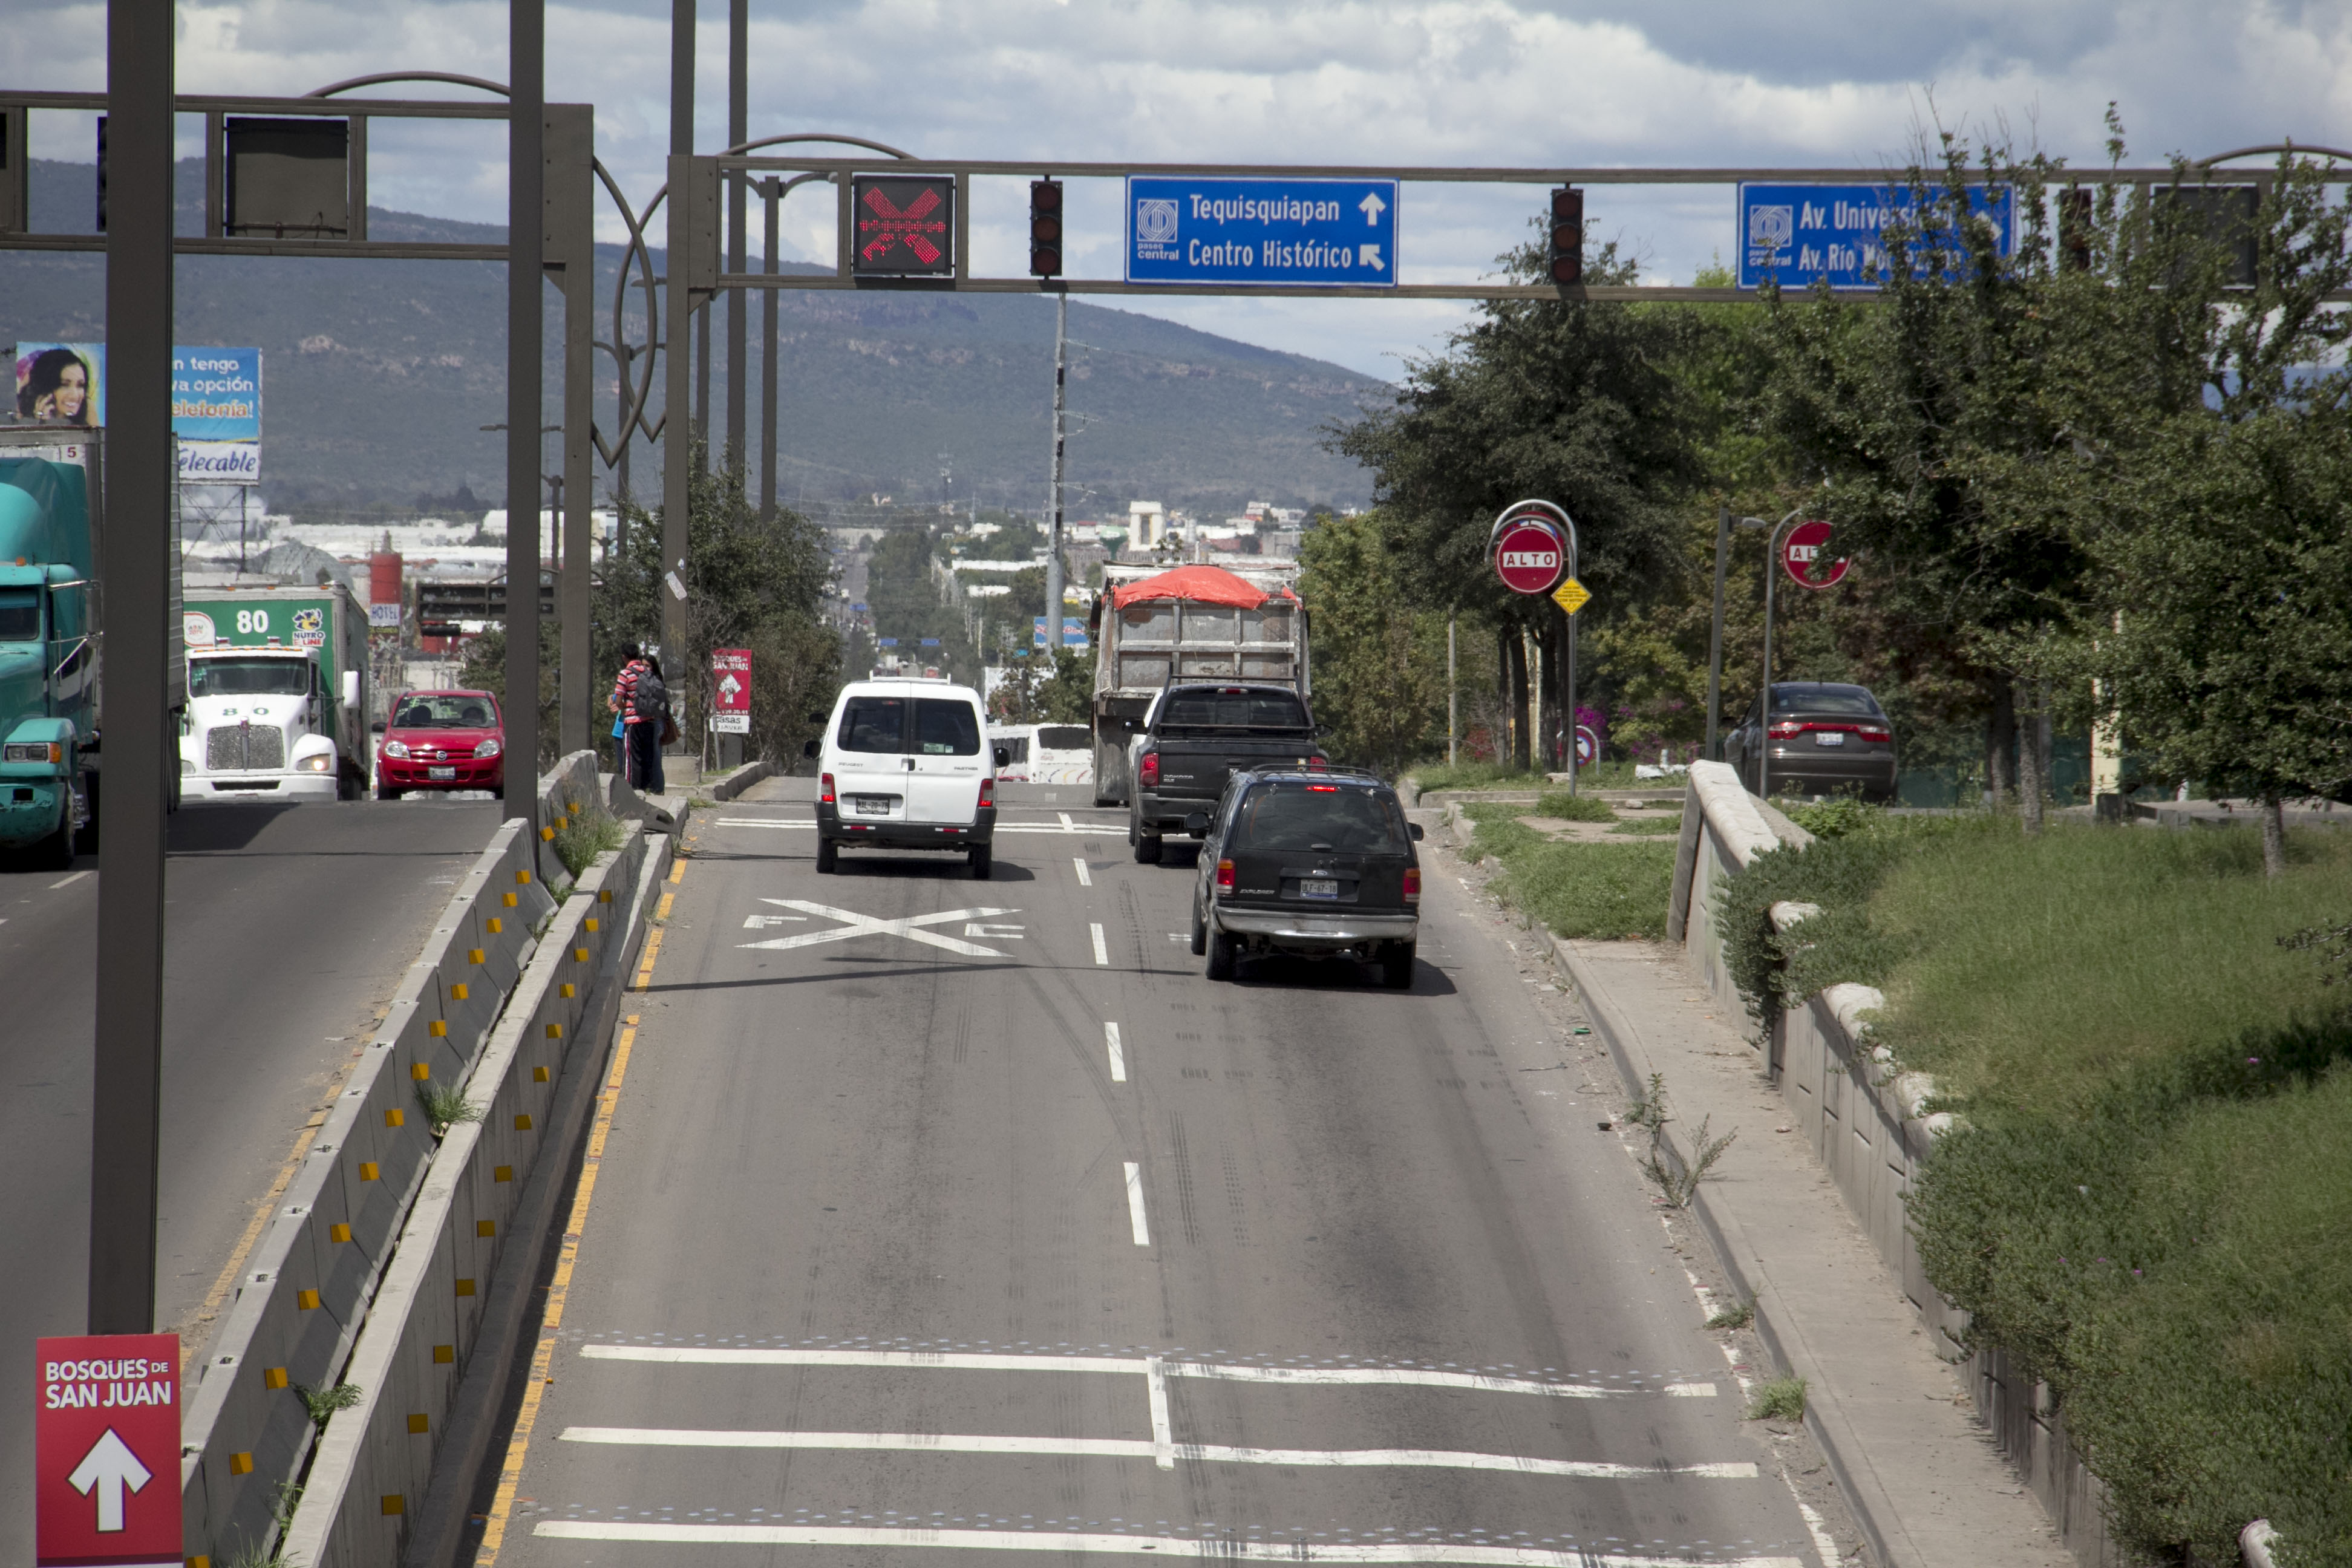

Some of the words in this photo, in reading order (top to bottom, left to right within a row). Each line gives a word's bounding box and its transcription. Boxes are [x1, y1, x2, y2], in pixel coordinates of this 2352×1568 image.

[1190, 194, 1339, 226] Tequisquiapan
[1799, 200, 1828, 229] Av.
[1137, 249, 1179, 260] central
[1189, 238, 1253, 266] Centro
[1263, 239, 1351, 268] Histórico
[1798, 243, 1823, 271] Av.
[1828, 243, 1855, 271] Río
[190, 357, 239, 374] tengo
[194, 376, 253, 396] opción
[172, 399, 253, 418] elefonía!
[67, 446, 77, 458] 5
[1507, 554, 1553, 566] ALTO
[237, 610, 269, 633] 80
[371, 606, 397, 619] HOTEL
[1302, 883, 1336, 893] ULF-67-18
[45, 1359, 148, 1382] BOSQUES
[151, 1362, 169, 1373] DE
[45, 1383, 97, 1408] SAN
[102, 1380, 171, 1408] JUAN
